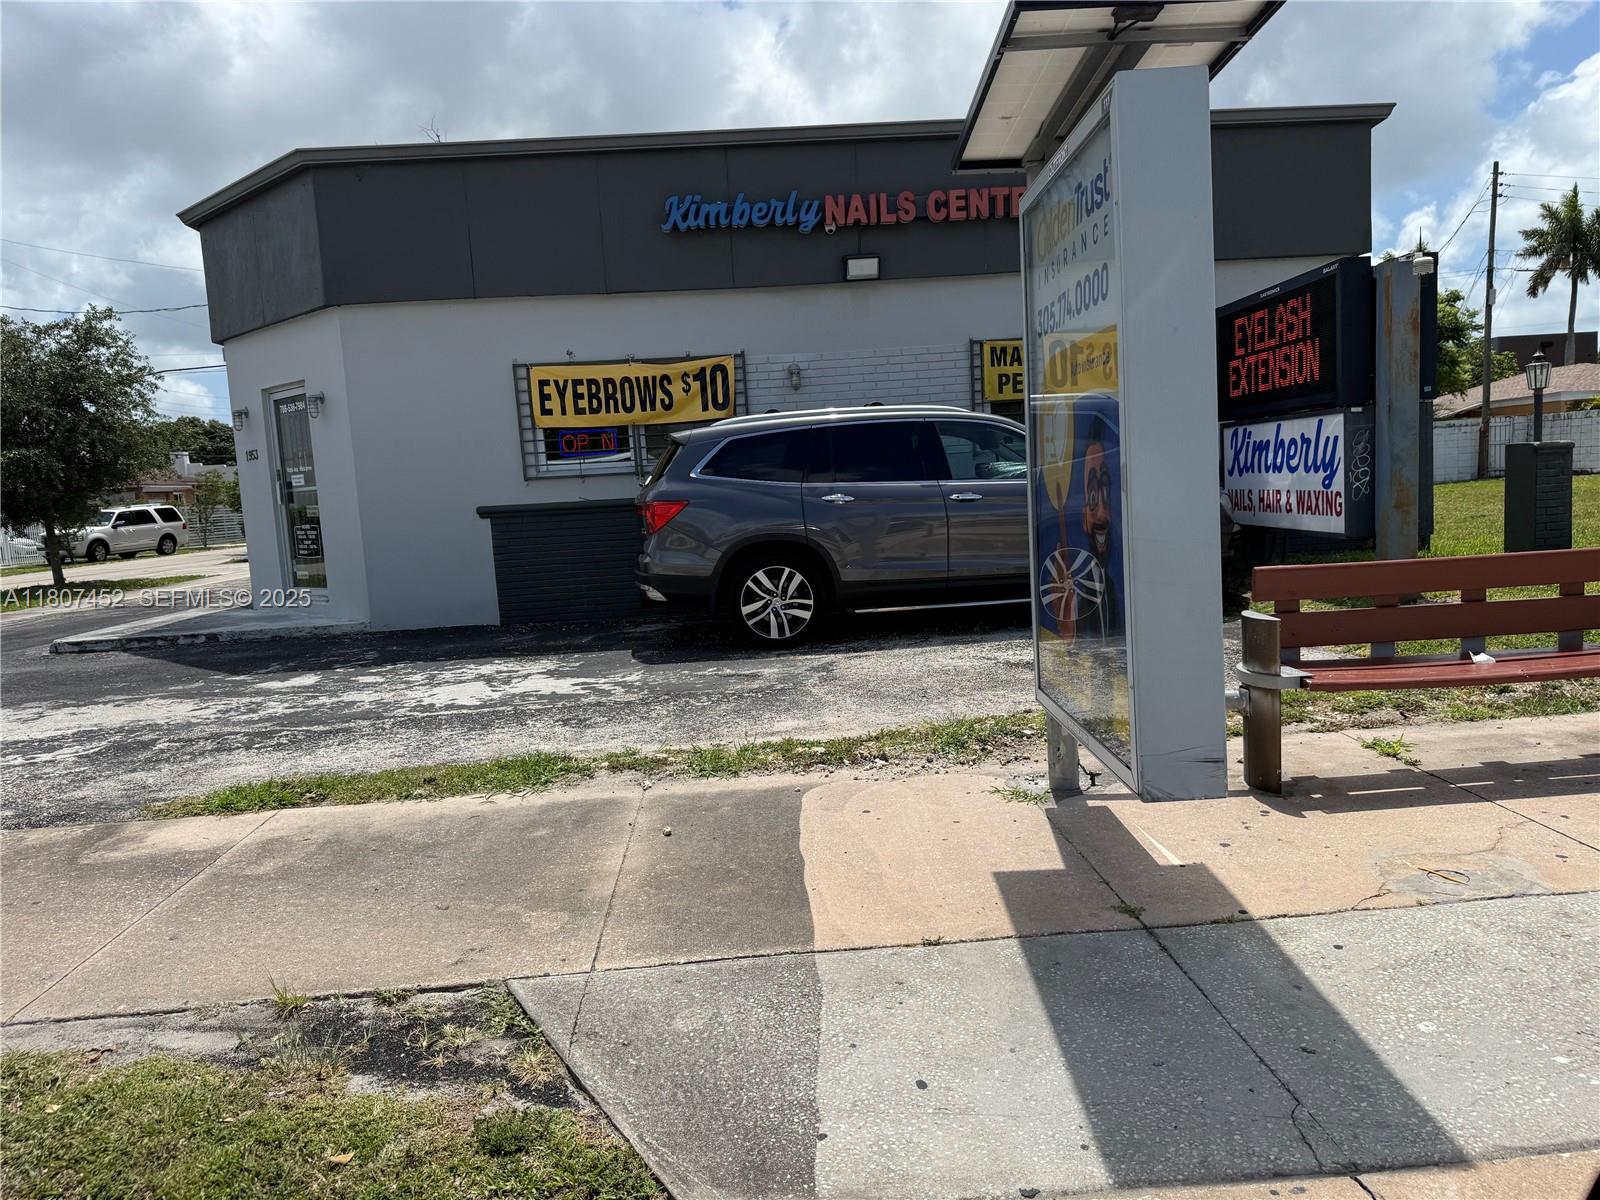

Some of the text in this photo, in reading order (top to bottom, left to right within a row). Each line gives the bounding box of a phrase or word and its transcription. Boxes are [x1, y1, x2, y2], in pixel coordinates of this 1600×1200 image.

[661, 190, 822, 234] Kimberly
[824, 191, 917, 227] NAILS
[1038, 213, 1109, 290] INSURANCE
[1037, 262, 1109, 339] 305.774.0000
[1234, 293, 1312, 357] EYELASH
[537, 363, 731, 416] EYEBROWS $10
[1229, 337, 1321, 398] EXTENSION
[562, 433, 615, 453] OPN
[1227, 418, 1340, 490] Kimberly
[1227, 488, 1343, 518] NAILS, HAIR & WAXING
